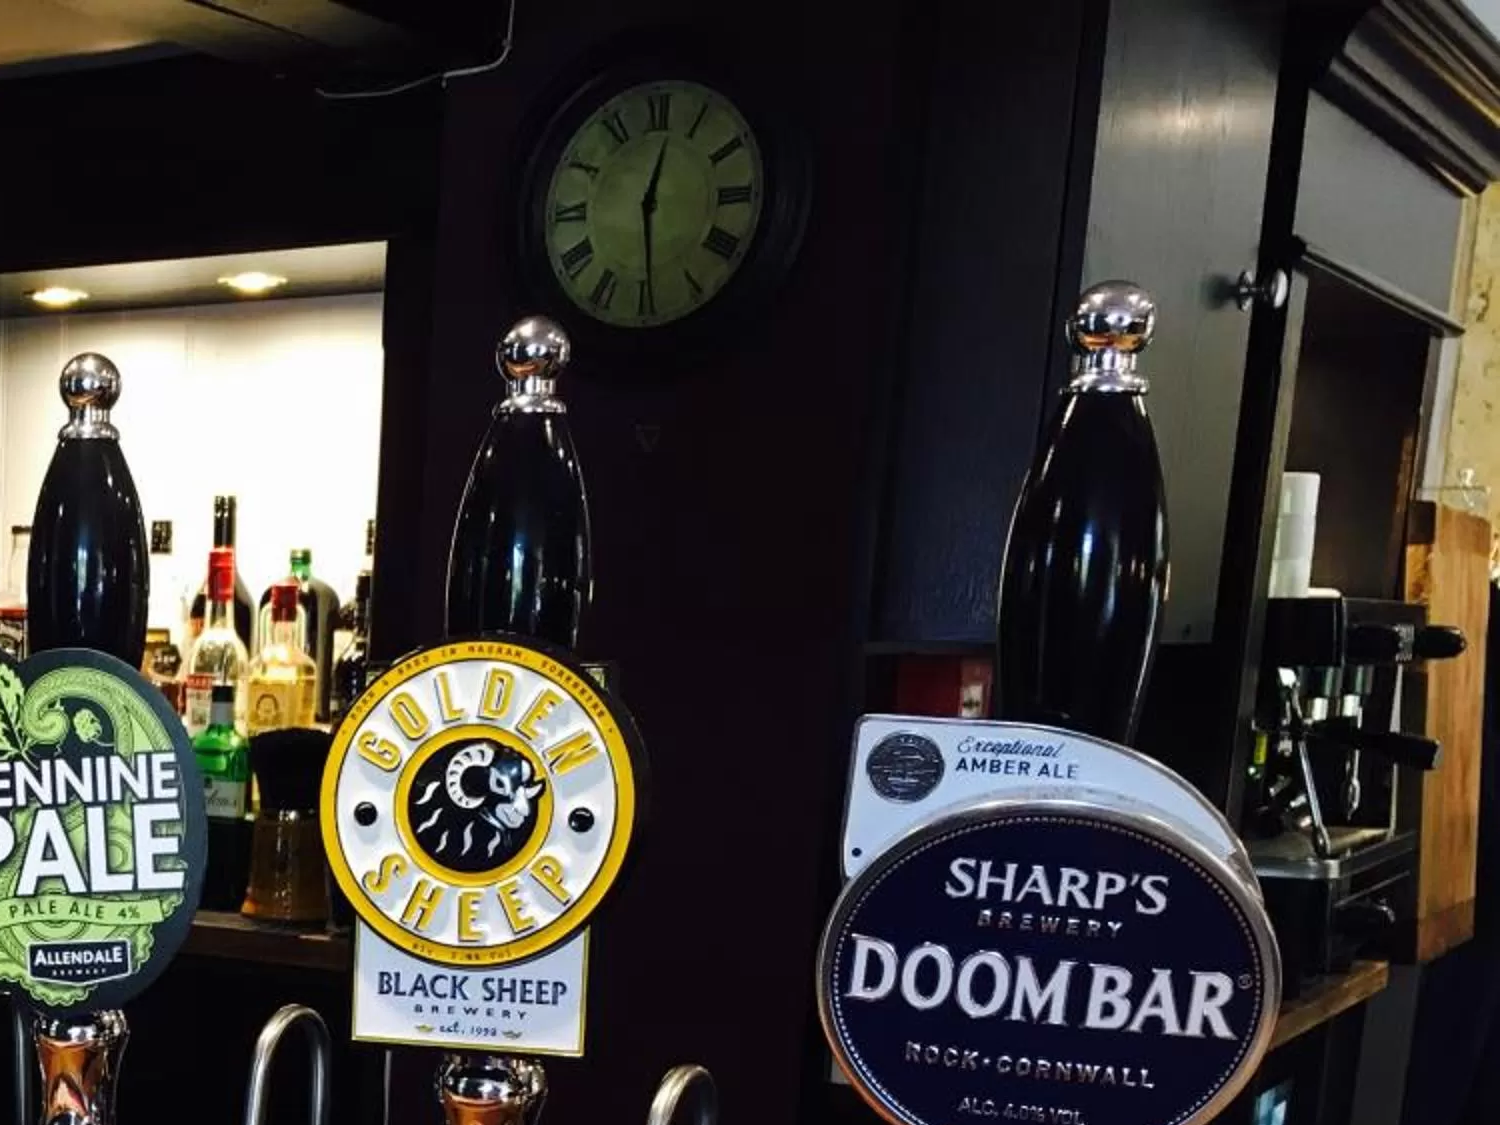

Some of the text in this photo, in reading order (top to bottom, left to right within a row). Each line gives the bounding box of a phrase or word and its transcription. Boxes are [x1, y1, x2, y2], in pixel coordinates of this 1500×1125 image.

[356, 666, 602, 775] GOLDEN
[956, 735, 1067, 759] Exceptional
[955, 756, 1080, 781] AMBER ALE
[361, 852, 572, 944] SHEEP
[944, 857, 1171, 916] SHARP'S
[8, 899, 141, 920] PALE ALE 4%
[976, 907, 1125, 940] BREWERY
[33, 945, 124, 967] ALLENDALE
[377, 970, 569, 1007] BLACK SHEEP
[843, 932, 1240, 1042] DOOM BAR
[413, 1003, 528, 1021] BREWERY
